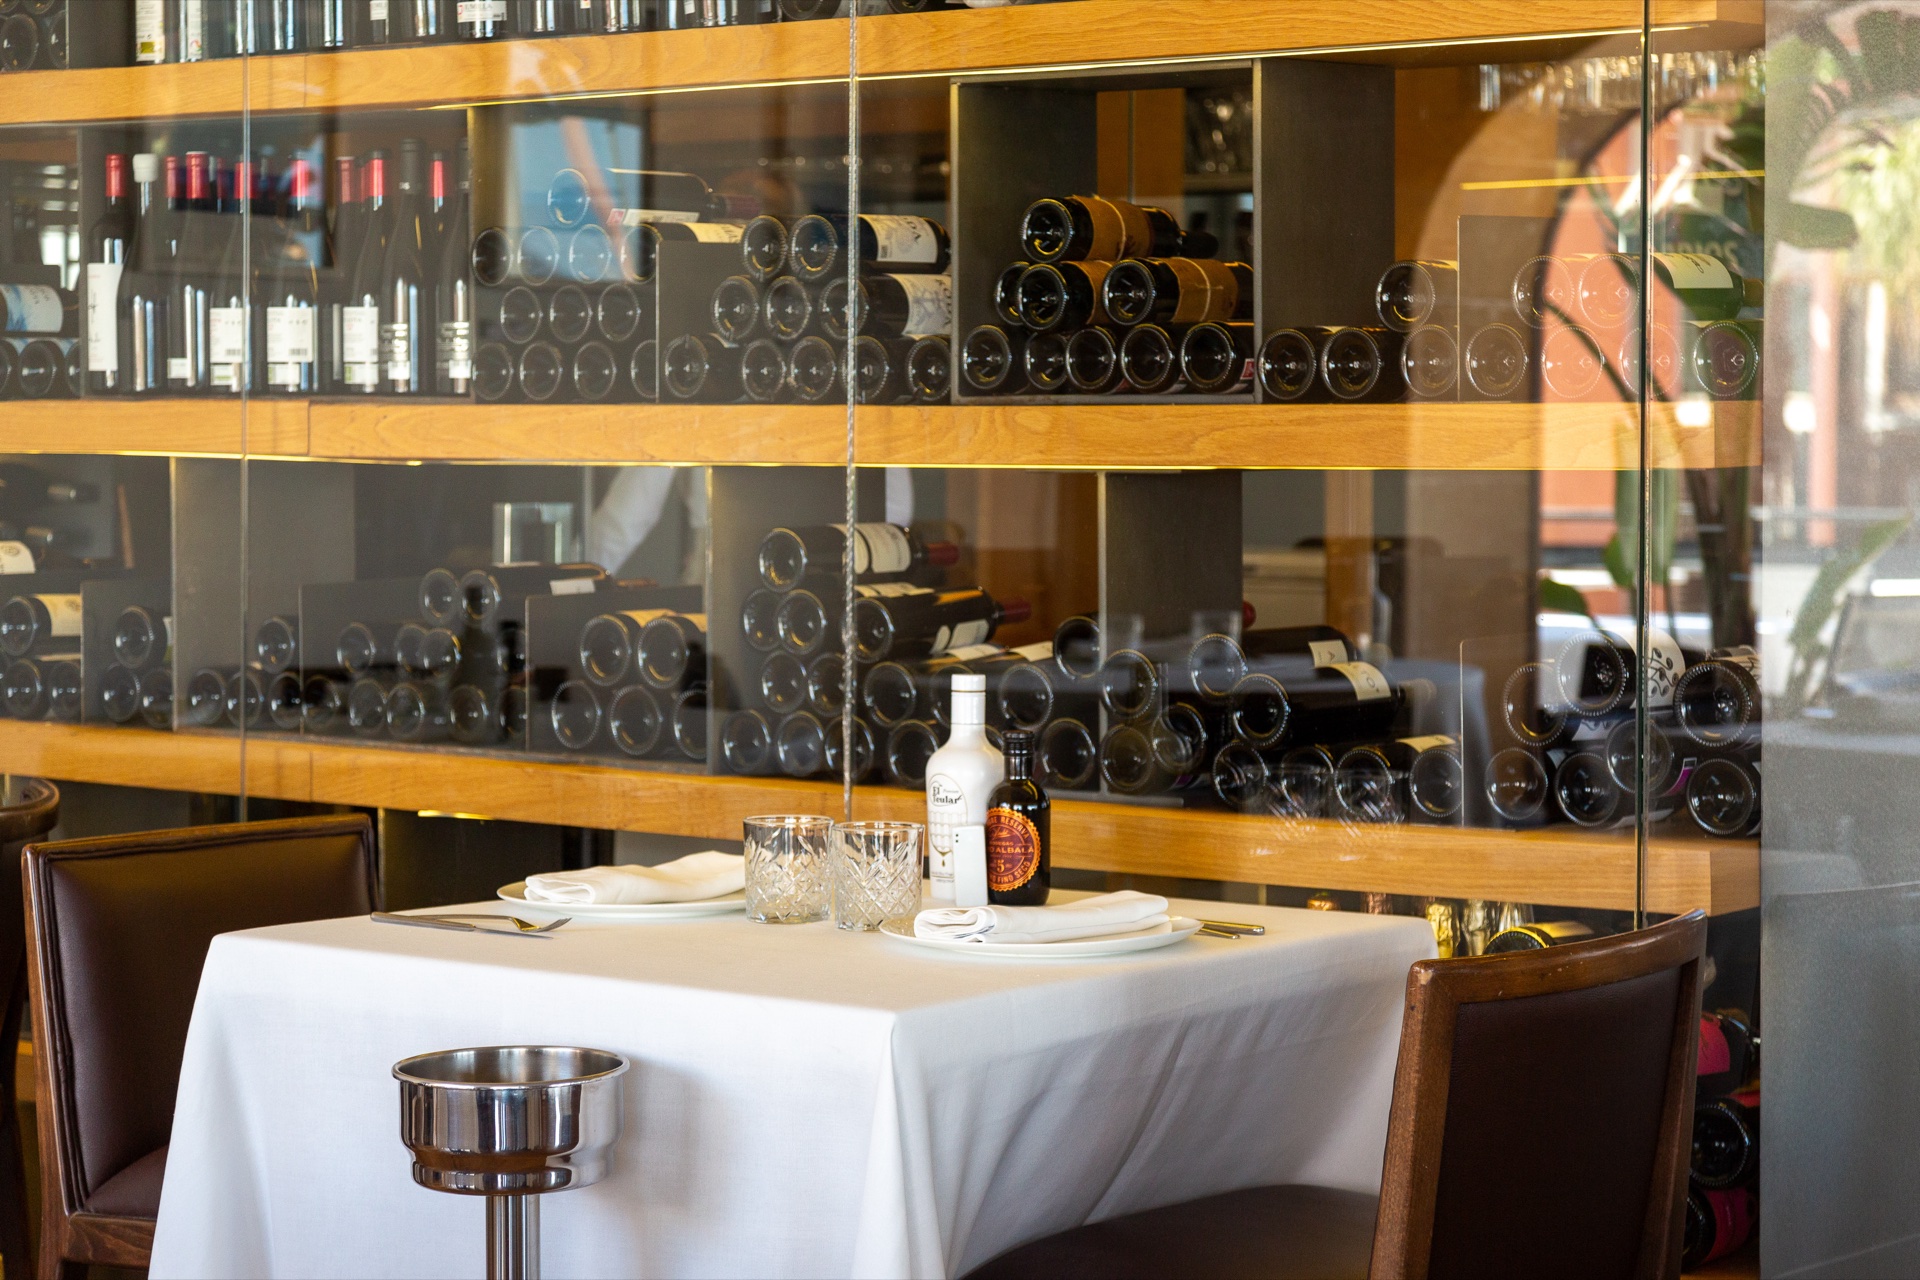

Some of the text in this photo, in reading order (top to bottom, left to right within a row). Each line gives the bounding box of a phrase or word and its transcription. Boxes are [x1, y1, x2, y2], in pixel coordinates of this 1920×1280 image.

[1000, 816, 1030, 840] RESERVA
[997, 875, 1014, 884] FINO
[1014, 861, 1032, 879] SECO
